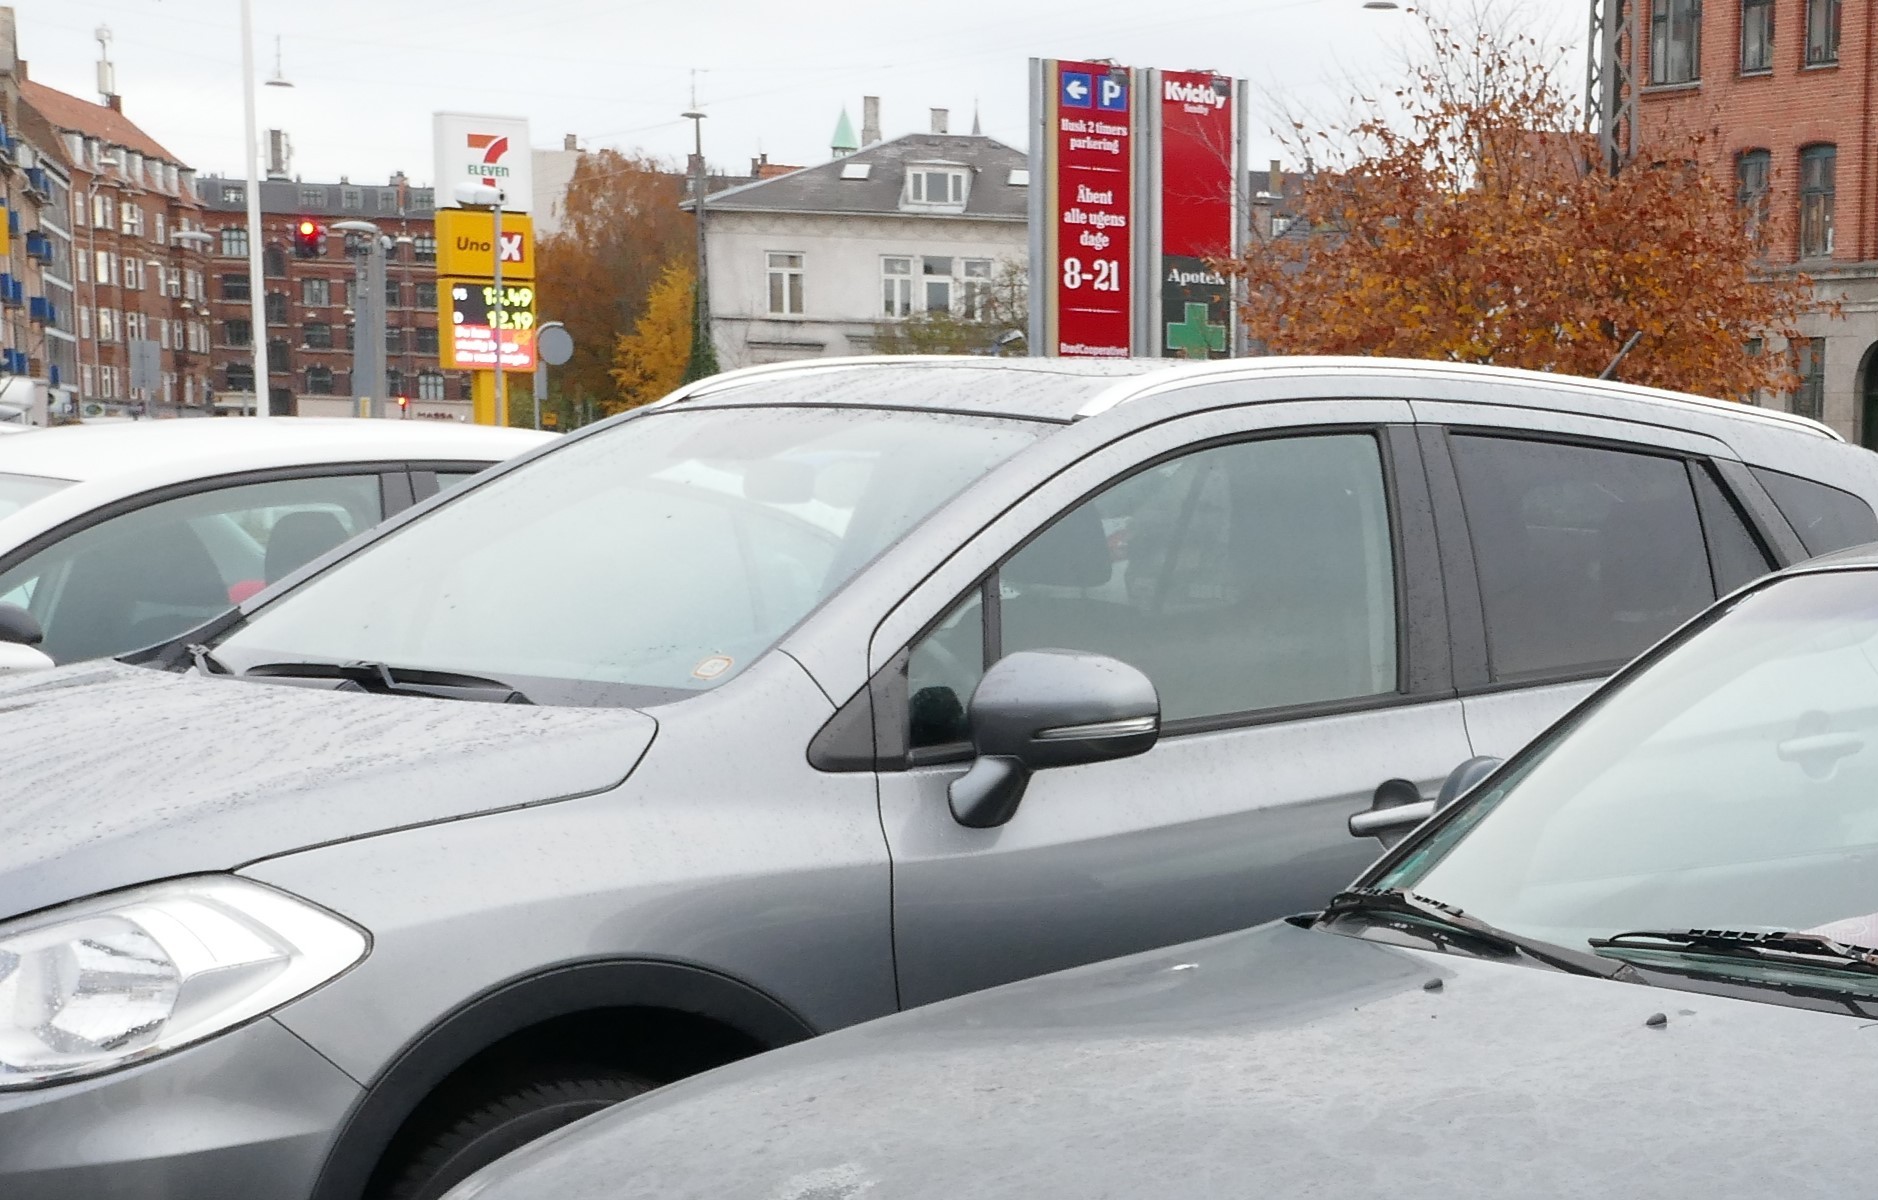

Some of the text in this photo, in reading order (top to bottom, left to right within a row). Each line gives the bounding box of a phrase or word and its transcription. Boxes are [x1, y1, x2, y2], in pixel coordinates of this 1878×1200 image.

[1165, 81, 1226, 109] Kvickly
[1061, 119, 1128, 136] Husk 2 timers
[1070, 136, 1119, 154] parkering
[467, 133, 508, 188] 7
[1077, 184, 1113, 204] Åbent
[1063, 208, 1126, 229] alle ugens
[457, 234, 521, 261] Uno X
[1080, 230, 1110, 250] dage
[1063, 257, 1121, 291] 8-21
[1168, 268, 1226, 287] Apotek
